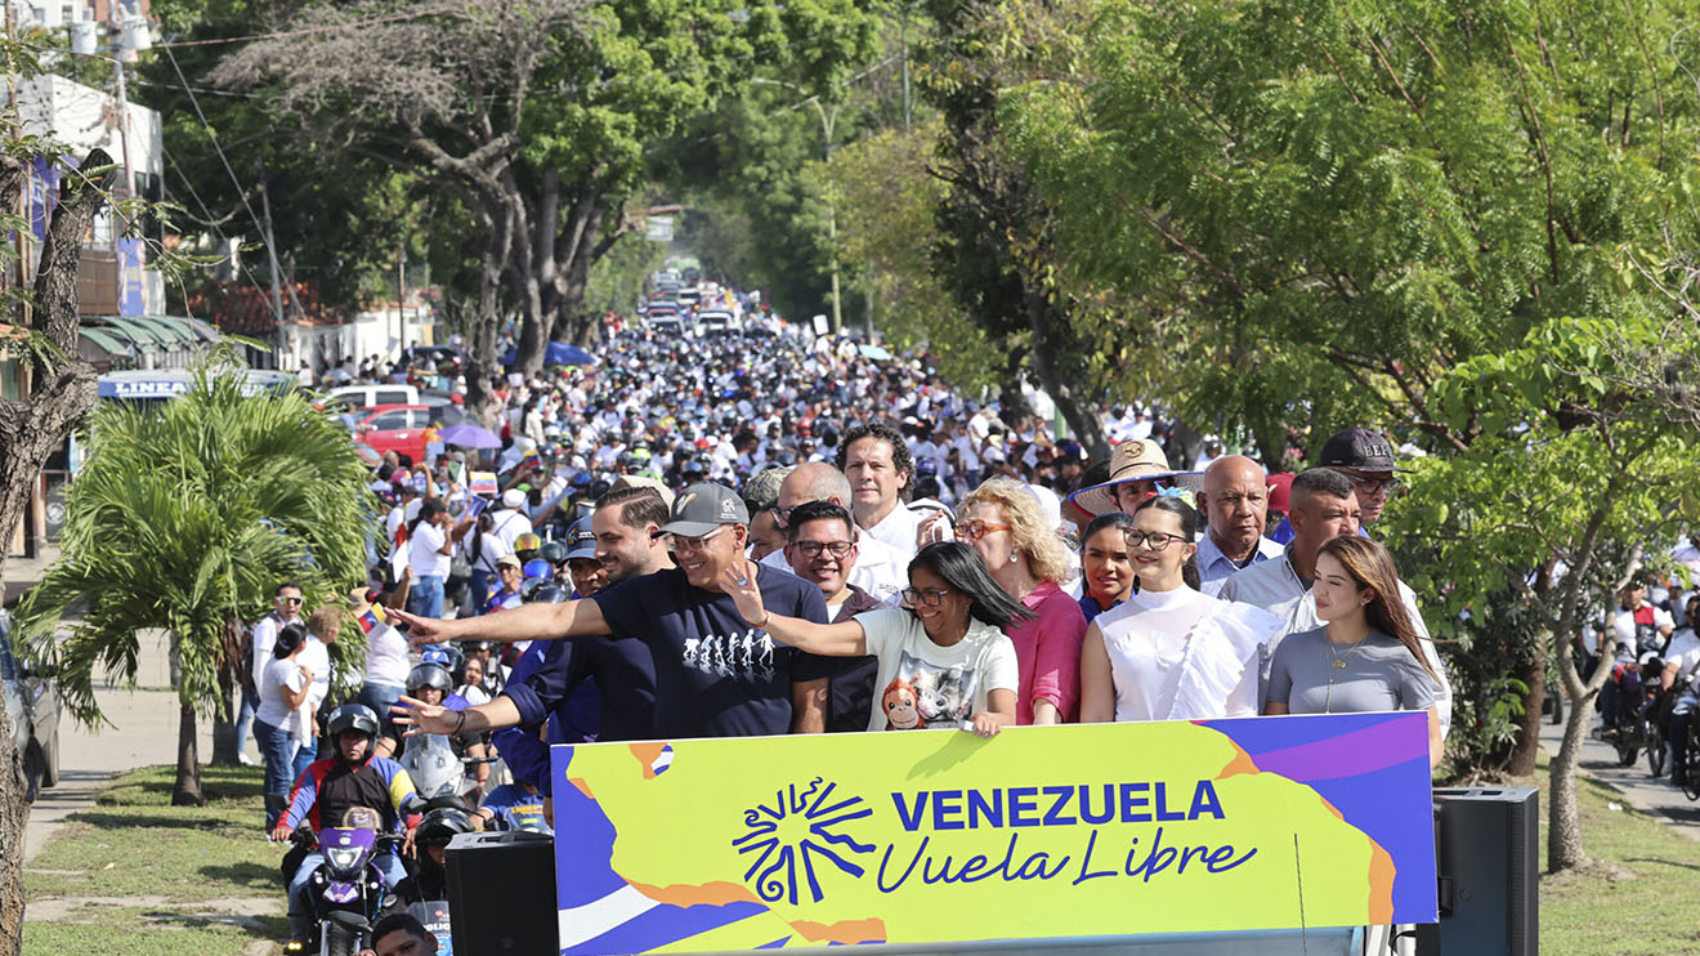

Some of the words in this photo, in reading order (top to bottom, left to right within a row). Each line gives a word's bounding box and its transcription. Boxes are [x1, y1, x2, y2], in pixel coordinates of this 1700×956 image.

[115, 382, 187, 393] LINEA
[891, 780, 1226, 831] VENEZUELA
[877, 832, 1070, 893] Vuela
[1072, 827, 1258, 886] Libre
